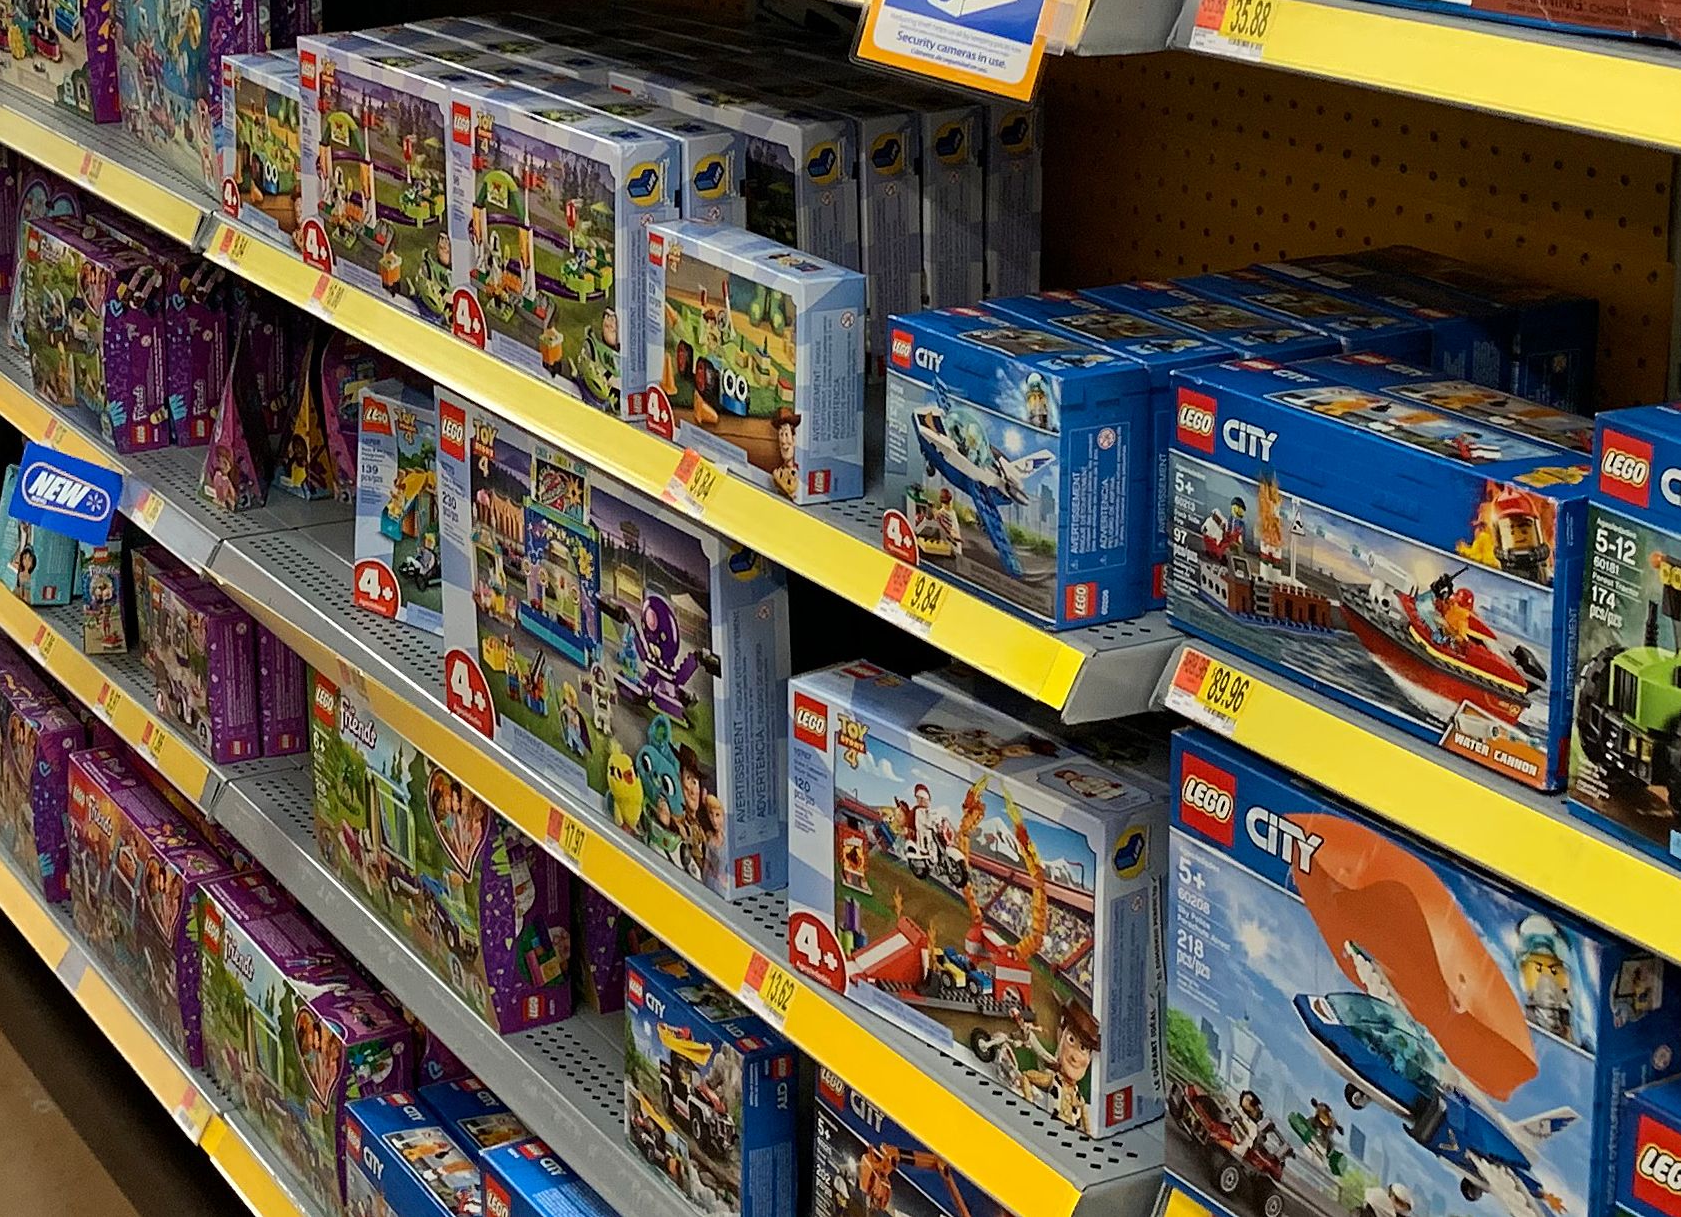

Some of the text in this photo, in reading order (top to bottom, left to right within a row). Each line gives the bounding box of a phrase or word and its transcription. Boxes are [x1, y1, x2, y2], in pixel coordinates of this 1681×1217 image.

[896, 30, 936, 51] Security
[937, 43, 977, 62] cameras
[977, 53, 987, 65] in
[988, 57, 1007, 69] use.
[453, 115, 471, 134] LEGO
[475, 111, 497, 132] TOY
[224, 182, 237, 205] 4+
[305, 224, 328, 262] 4+
[455, 297, 481, 335] 4+
[892, 339, 944, 373] LEGO CITY
[133, 385, 148, 422] Friends
[365, 404, 388, 424] LEGO
[648, 391, 669, 423] 4+
[441, 420, 463, 444] LEGO
[473, 418, 498, 444] TOY
[1178, 405, 1278, 463] LEGO CITY
[361, 464, 379, 475] 139
[478, 457, 489, 478] 4
[690, 463, 716, 502] 9.84
[1174, 472, 1194, 496] 5+
[1602, 452, 1647, 485] LEGO
[28, 470, 89, 509] NEW
[1070, 472, 1080, 554] AVERTISSEMENT
[887, 518, 914, 548] 4+
[1173, 527, 1187, 544] 97
[1594, 529, 1637, 566] 5-12
[1593, 555, 1620, 575] 60181
[358, 568, 394, 601] 4+
[910, 577, 944, 615] 9.84
[1074, 584, 1088, 618] LEGO
[1591, 585, 1617, 609] 174
[1589, 604, 1624, 629] pcs/pzs
[451, 660, 486, 710] 4+
[1207, 663, 1250, 712] $89.96
[315, 683, 378, 750] LEGO Friends
[795, 707, 826, 737] LEGO
[838, 713, 870, 741] TOY
[313, 731, 326, 753] 6+
[1454, 732, 1539, 777] WATER CANNON
[736, 719, 745, 824] AVERTISSEMENT
[845, 749, 859, 770] 4
[794, 776, 811, 794] 120
[88, 793, 113, 838] Friends
[1182, 776, 1325, 875] LEGO CITY
[563, 822, 585, 856] 17.97
[742, 857, 754, 884] LEGO
[1178, 856, 1206, 890] 5+
[1178, 887, 1211, 916] 60208
[204, 917, 256, 982] LEGO Friends
[796, 920, 838, 972] 4+
[1177, 928, 1205, 960] 218
[1176, 948, 1212, 981] pcs/pzs
[526, 995, 538, 1019] LEGO
[646, 992, 666, 1019] CITY
[767, 969, 795, 1012] 13.62
[402, 1106, 426, 1121] CITY
[821, 1068, 886, 1133] LEGO CITY
[1112, 1091, 1127, 1120] LEGO
[362, 1146, 385, 1181] CITY
[539, 1157, 567, 1176] CITY
